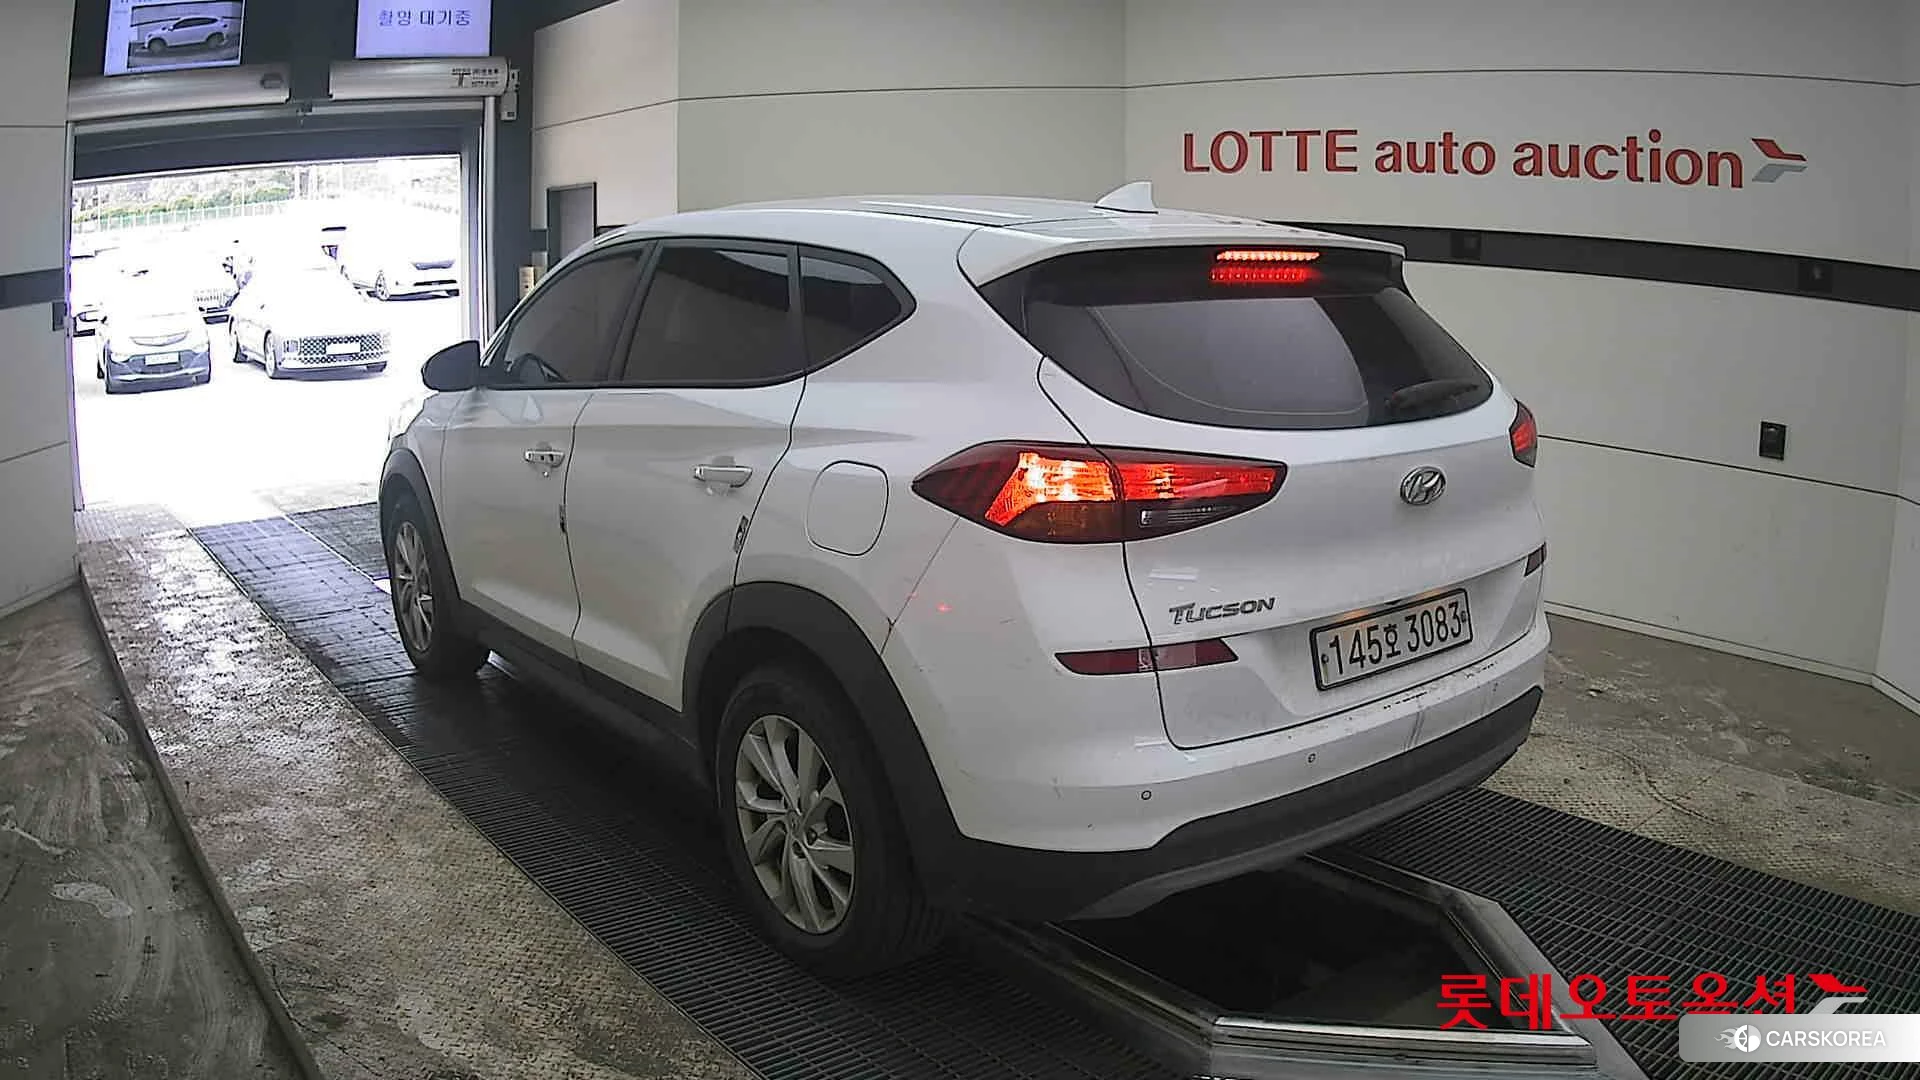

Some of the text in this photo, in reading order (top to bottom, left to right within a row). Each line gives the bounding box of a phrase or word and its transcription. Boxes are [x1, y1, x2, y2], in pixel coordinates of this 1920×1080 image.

[420, 9, 472, 27] 대기중
[1183, 129, 1744, 188] LOTTE auto auction
[1168, 597, 1276, 625] TUCSON
[1329, 601, 1462, 675] 145호 3083
